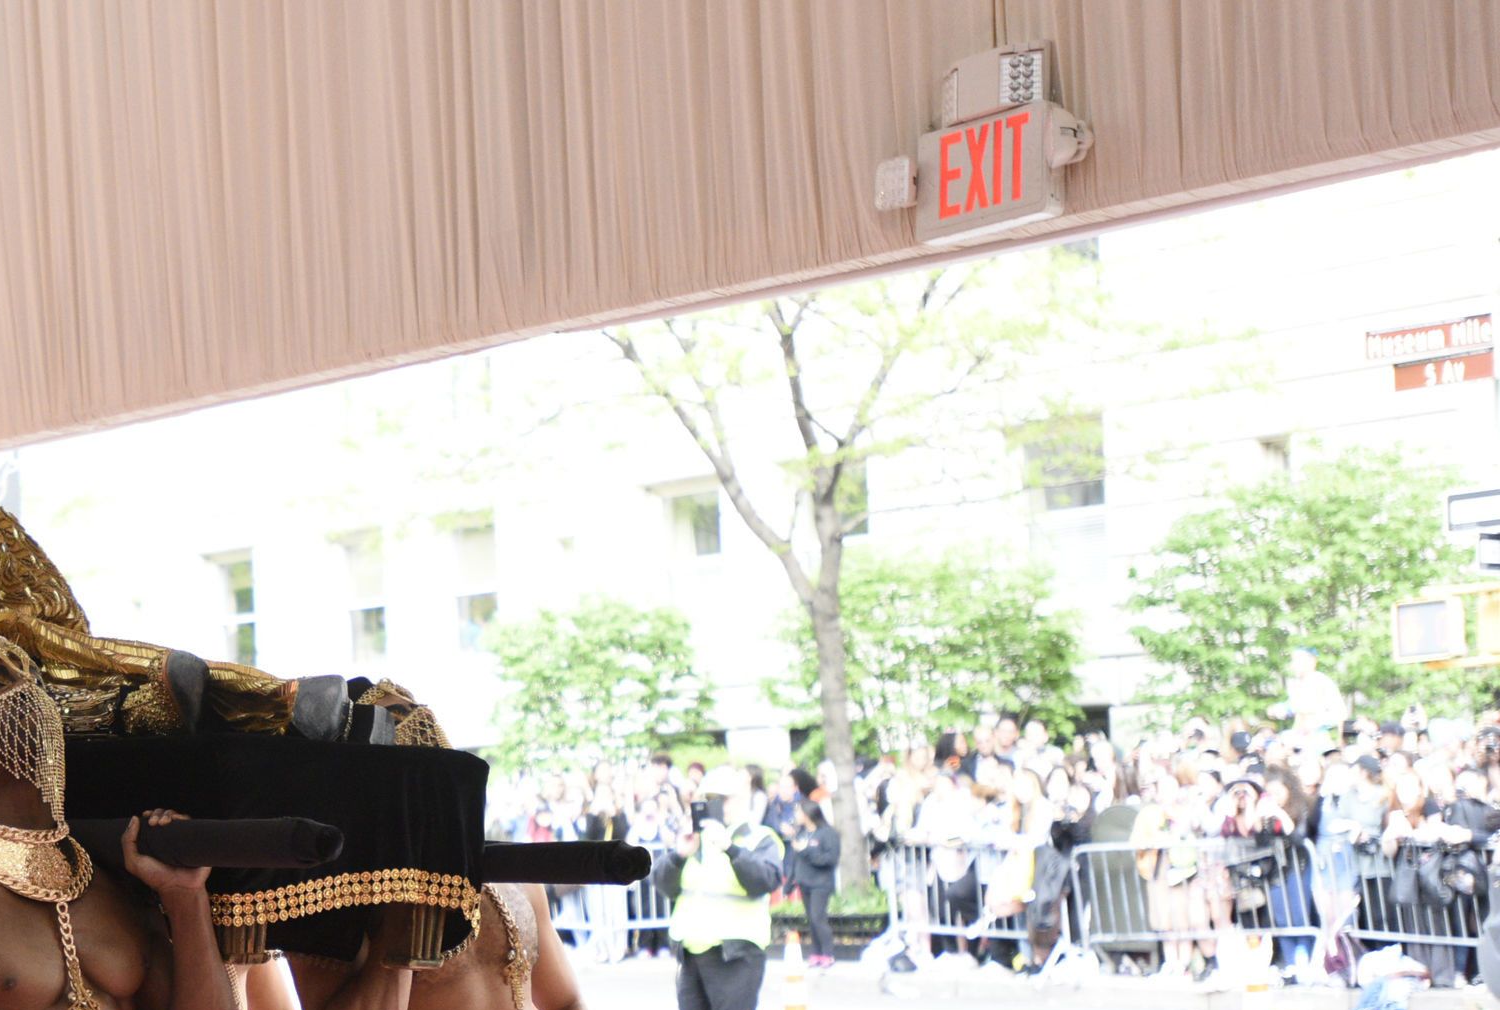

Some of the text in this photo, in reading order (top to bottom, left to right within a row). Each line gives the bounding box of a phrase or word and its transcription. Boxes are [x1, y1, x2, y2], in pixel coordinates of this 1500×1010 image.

[939, 112, 1031, 220] EXIT
[1367, 318, 1492, 359] Museum Mile
[1442, 359, 1466, 384] Av
